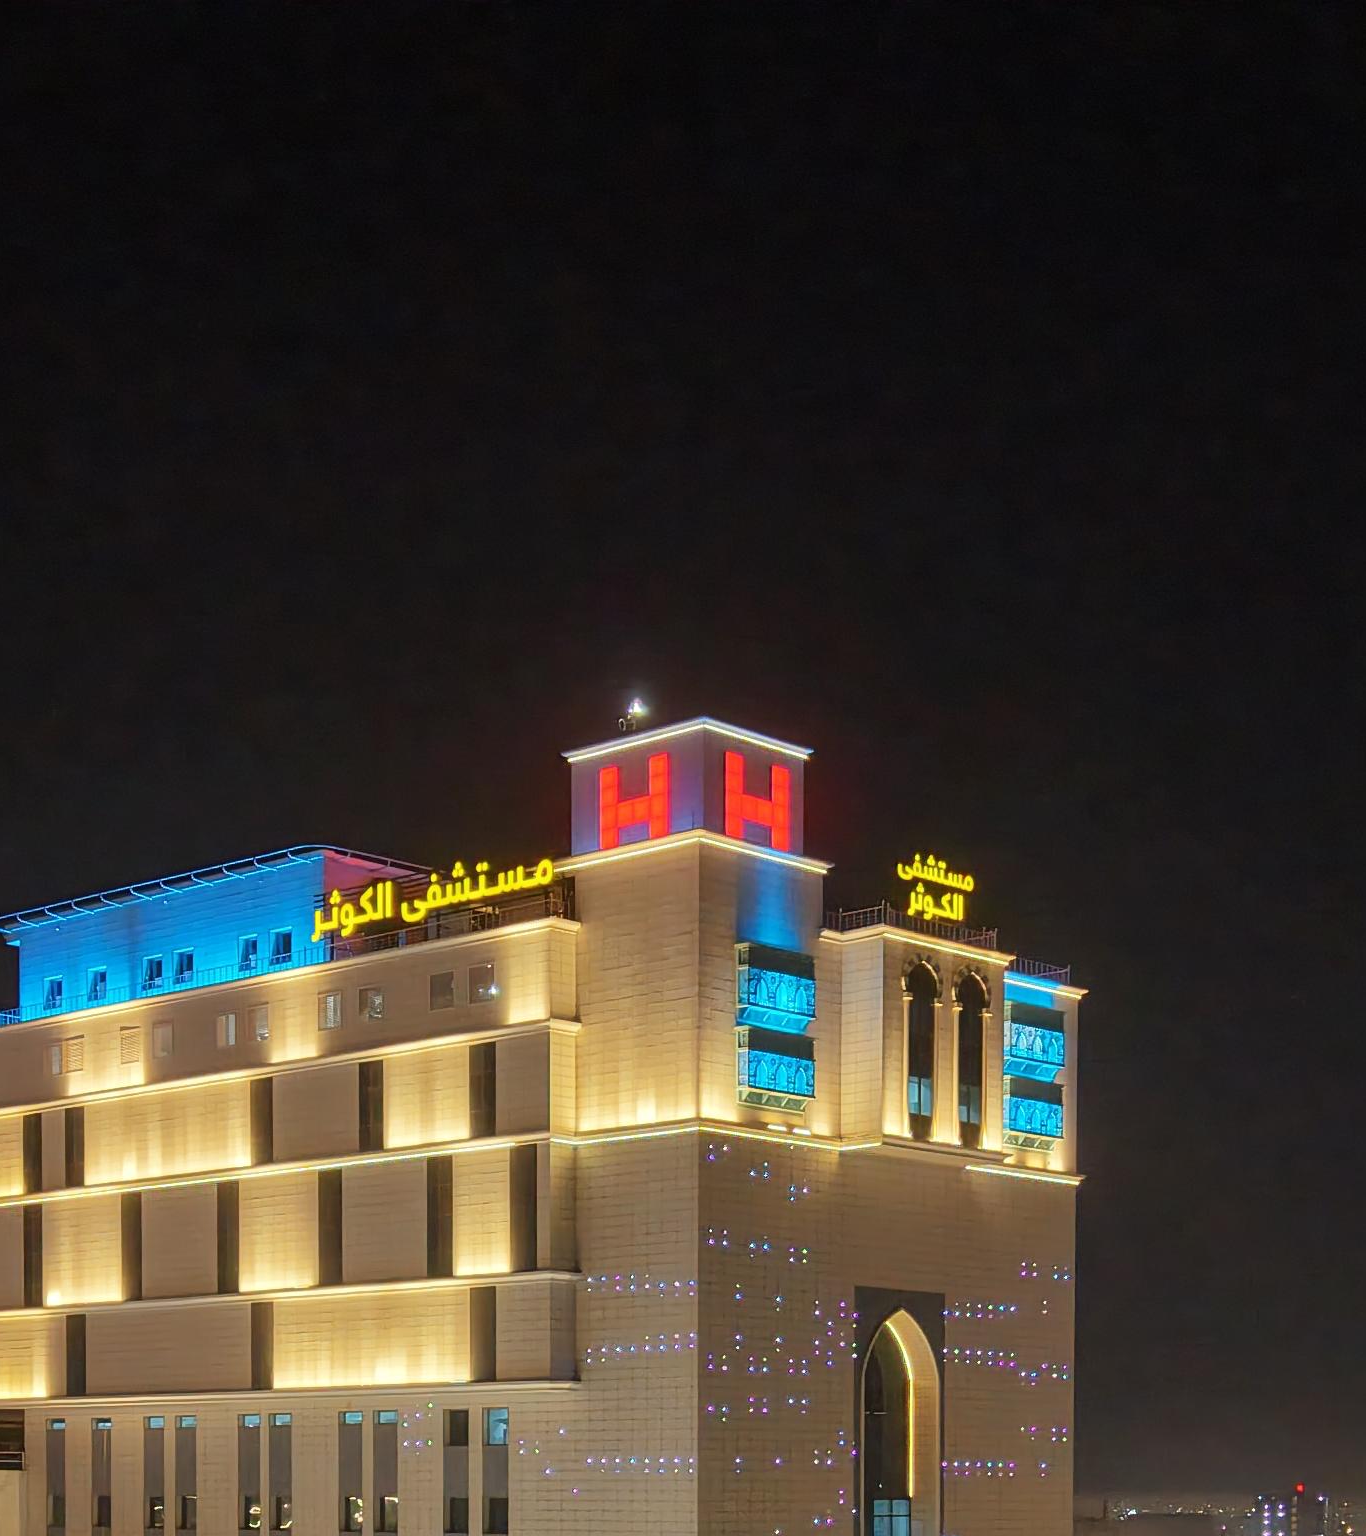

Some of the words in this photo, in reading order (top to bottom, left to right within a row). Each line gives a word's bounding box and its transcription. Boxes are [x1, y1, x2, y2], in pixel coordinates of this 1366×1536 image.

[599, 752, 669, 850] H
[725, 751, 790, 852] H
[401, 859, 554, 923] مستشفى
[897, 853, 974, 892] مستشفى
[907, 882, 964, 920] الكوثر
[311, 880, 393, 943] الكوثر
